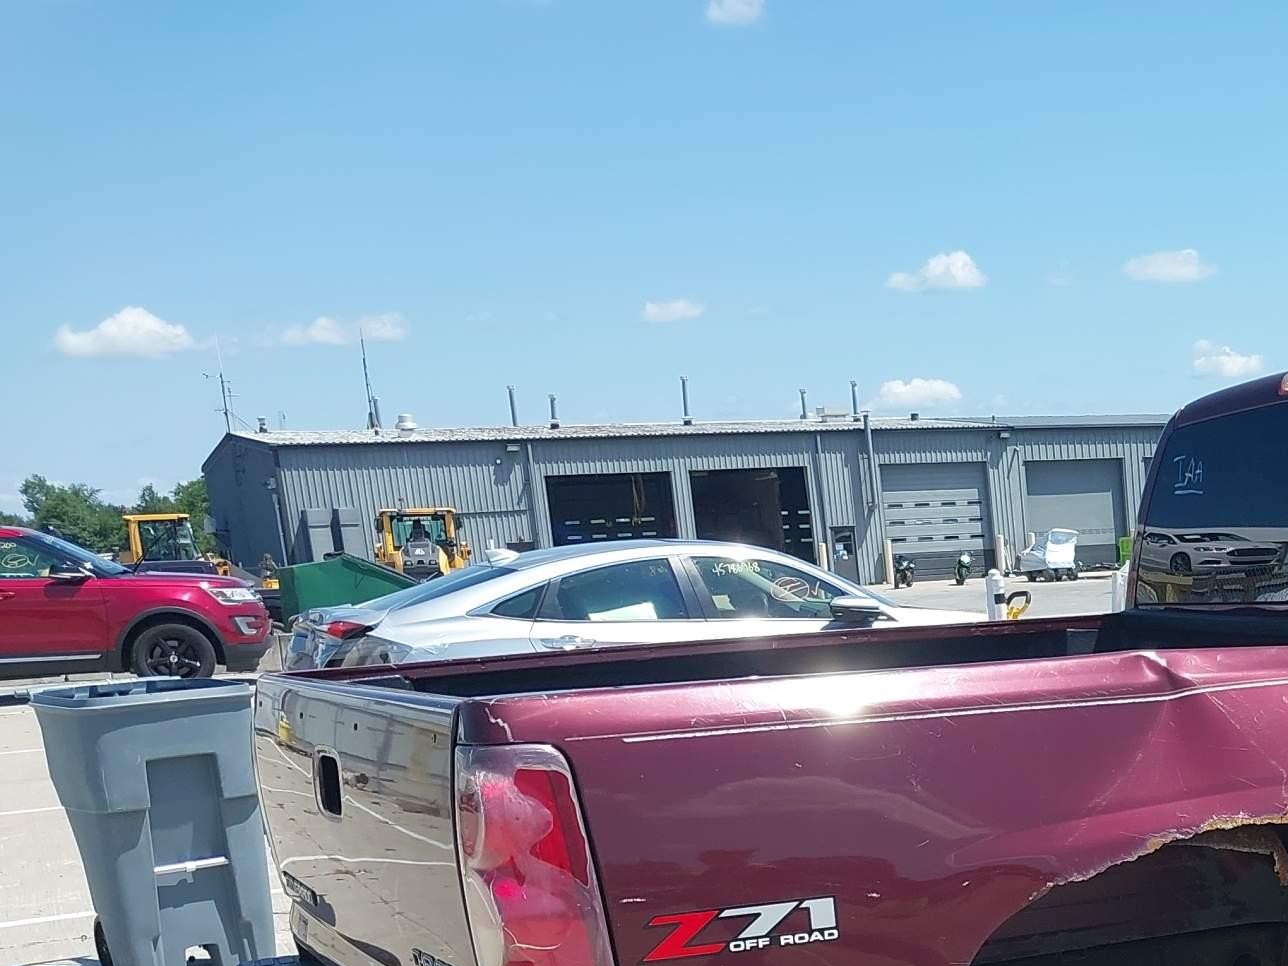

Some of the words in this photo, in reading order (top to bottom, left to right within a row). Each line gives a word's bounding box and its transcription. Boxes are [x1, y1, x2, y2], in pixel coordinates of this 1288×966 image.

[1173, 455, 1203, 488] IAA
[643, 897, 837, 962] Z71
[729, 937, 770, 953] OFF
[780, 929, 839, 946] ROAD
